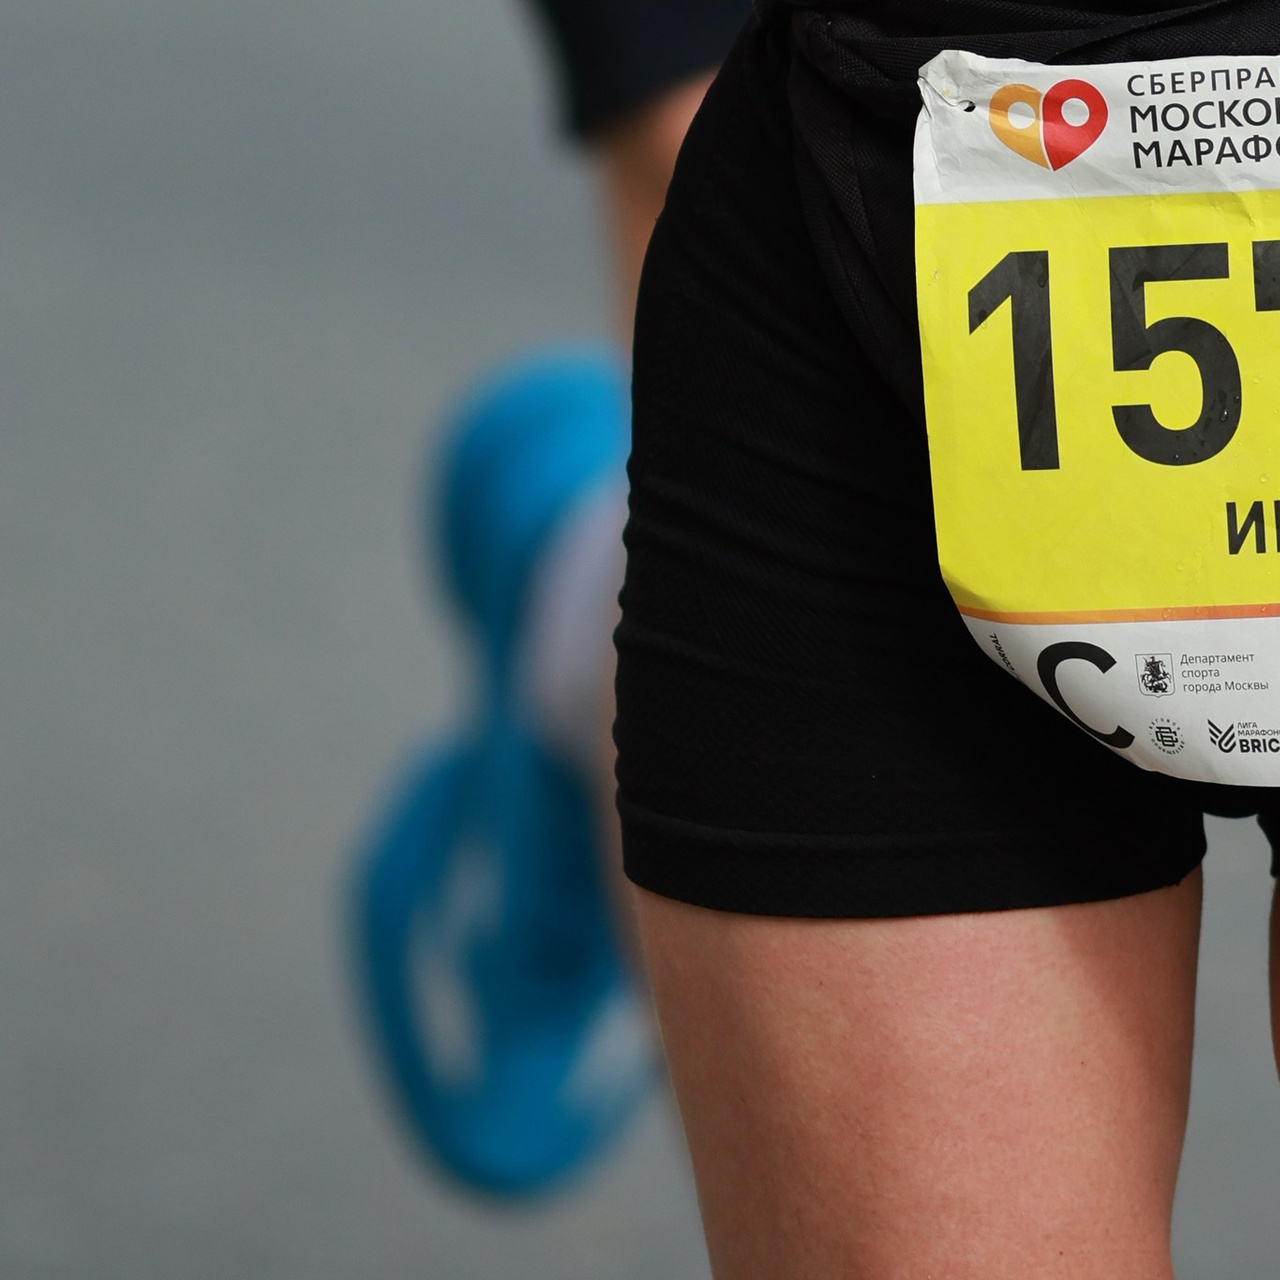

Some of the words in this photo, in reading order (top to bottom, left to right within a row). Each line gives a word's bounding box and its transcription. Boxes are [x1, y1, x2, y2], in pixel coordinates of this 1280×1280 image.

[1179, 652, 1256, 666] Департамент
[1181, 668, 1221, 681] спорта
[1183, 683, 1222, 694] города
[1224, 680, 1269, 691] Москвы
[1236, 721, 1258, 730] ЛИГА
